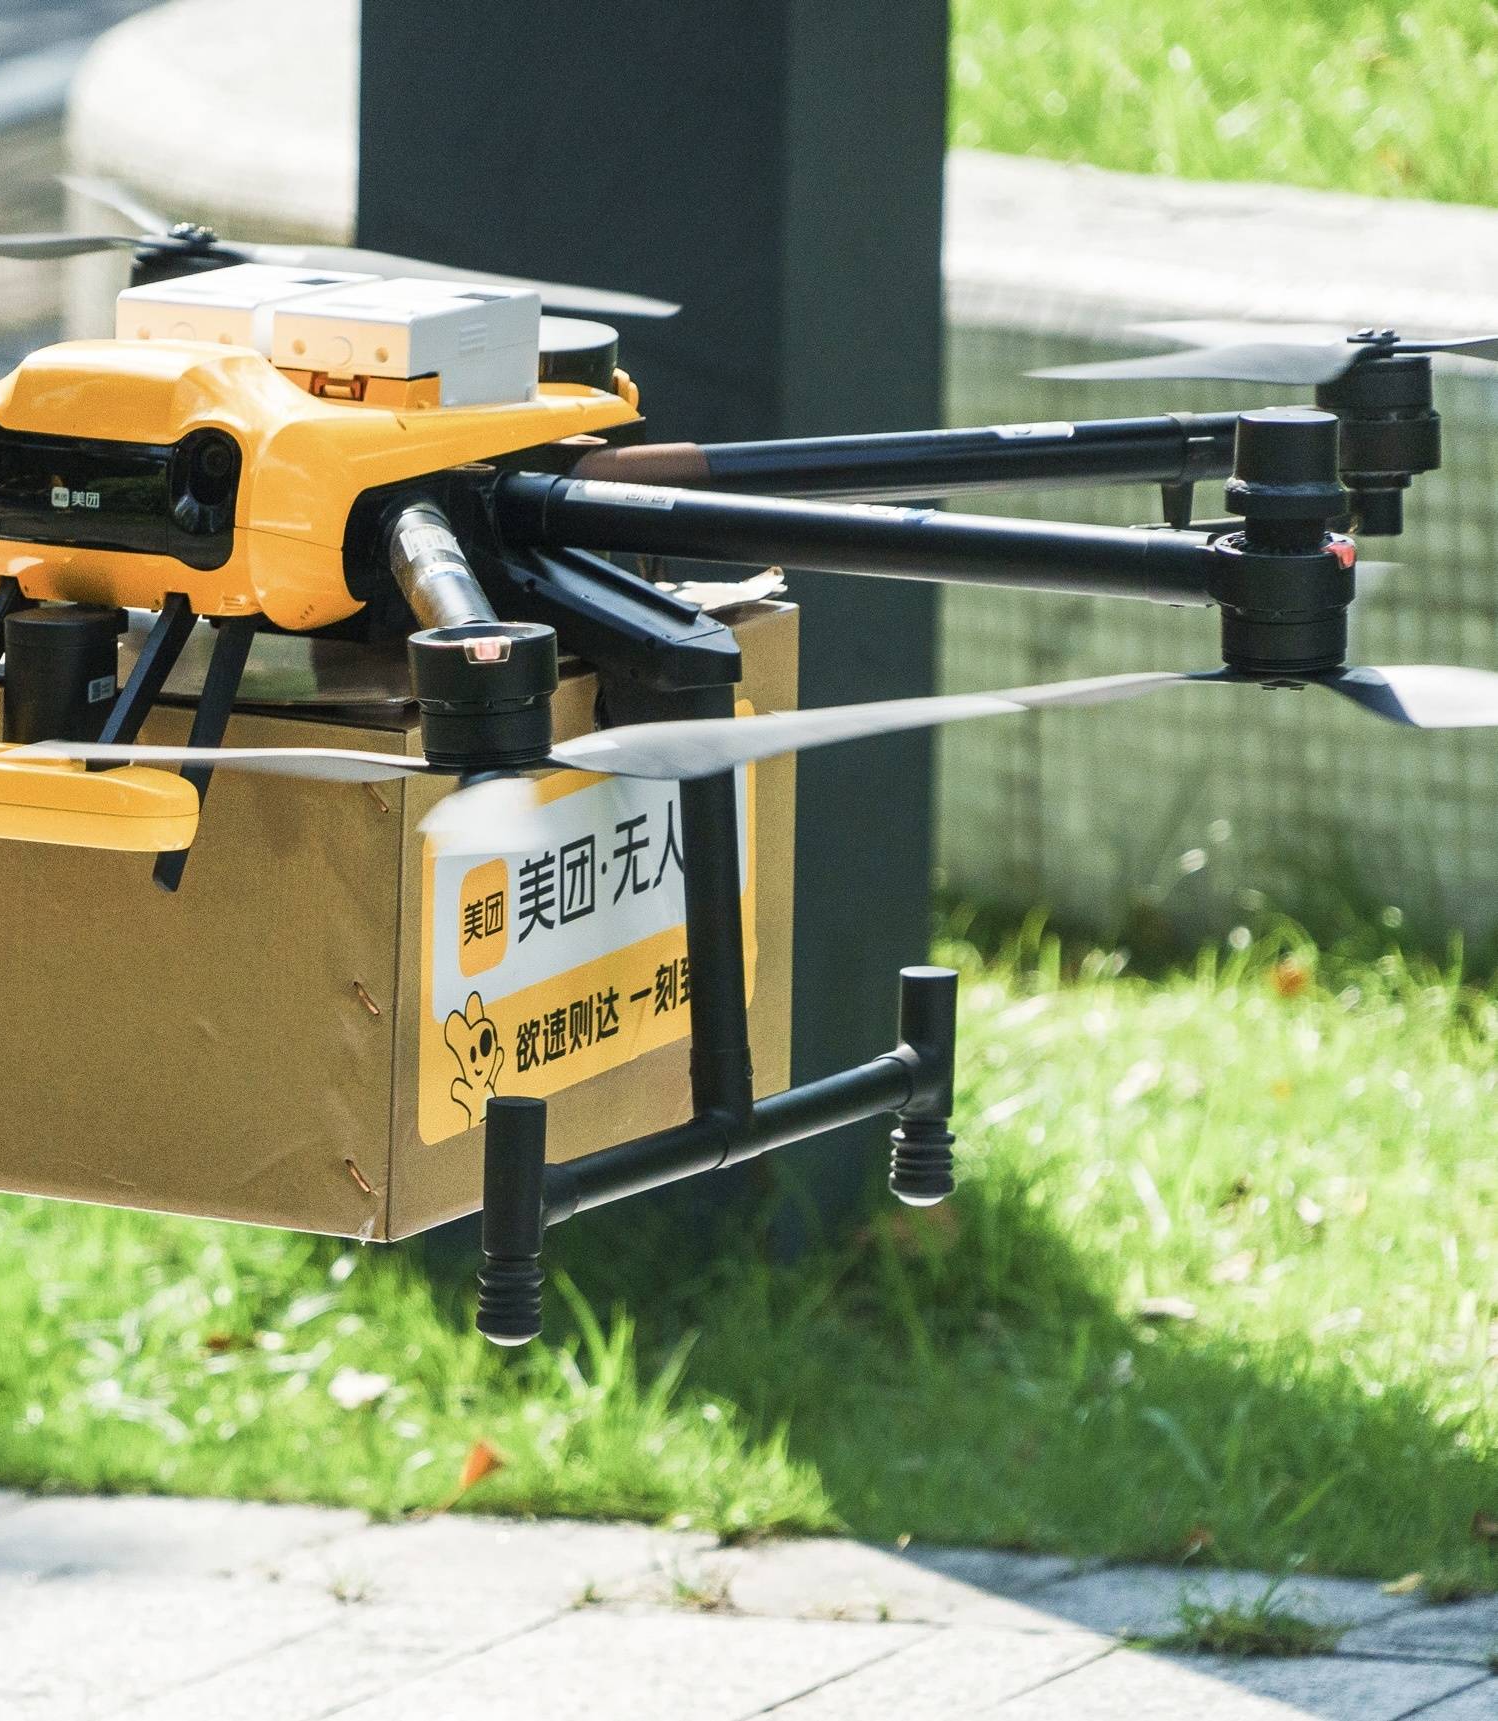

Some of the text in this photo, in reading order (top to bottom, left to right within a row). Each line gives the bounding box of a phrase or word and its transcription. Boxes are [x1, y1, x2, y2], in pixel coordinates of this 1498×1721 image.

[71, 491, 100, 508] 美团
[464, 890, 504, 946] 美团
[516, 986, 620, 1073] 欲速则达
